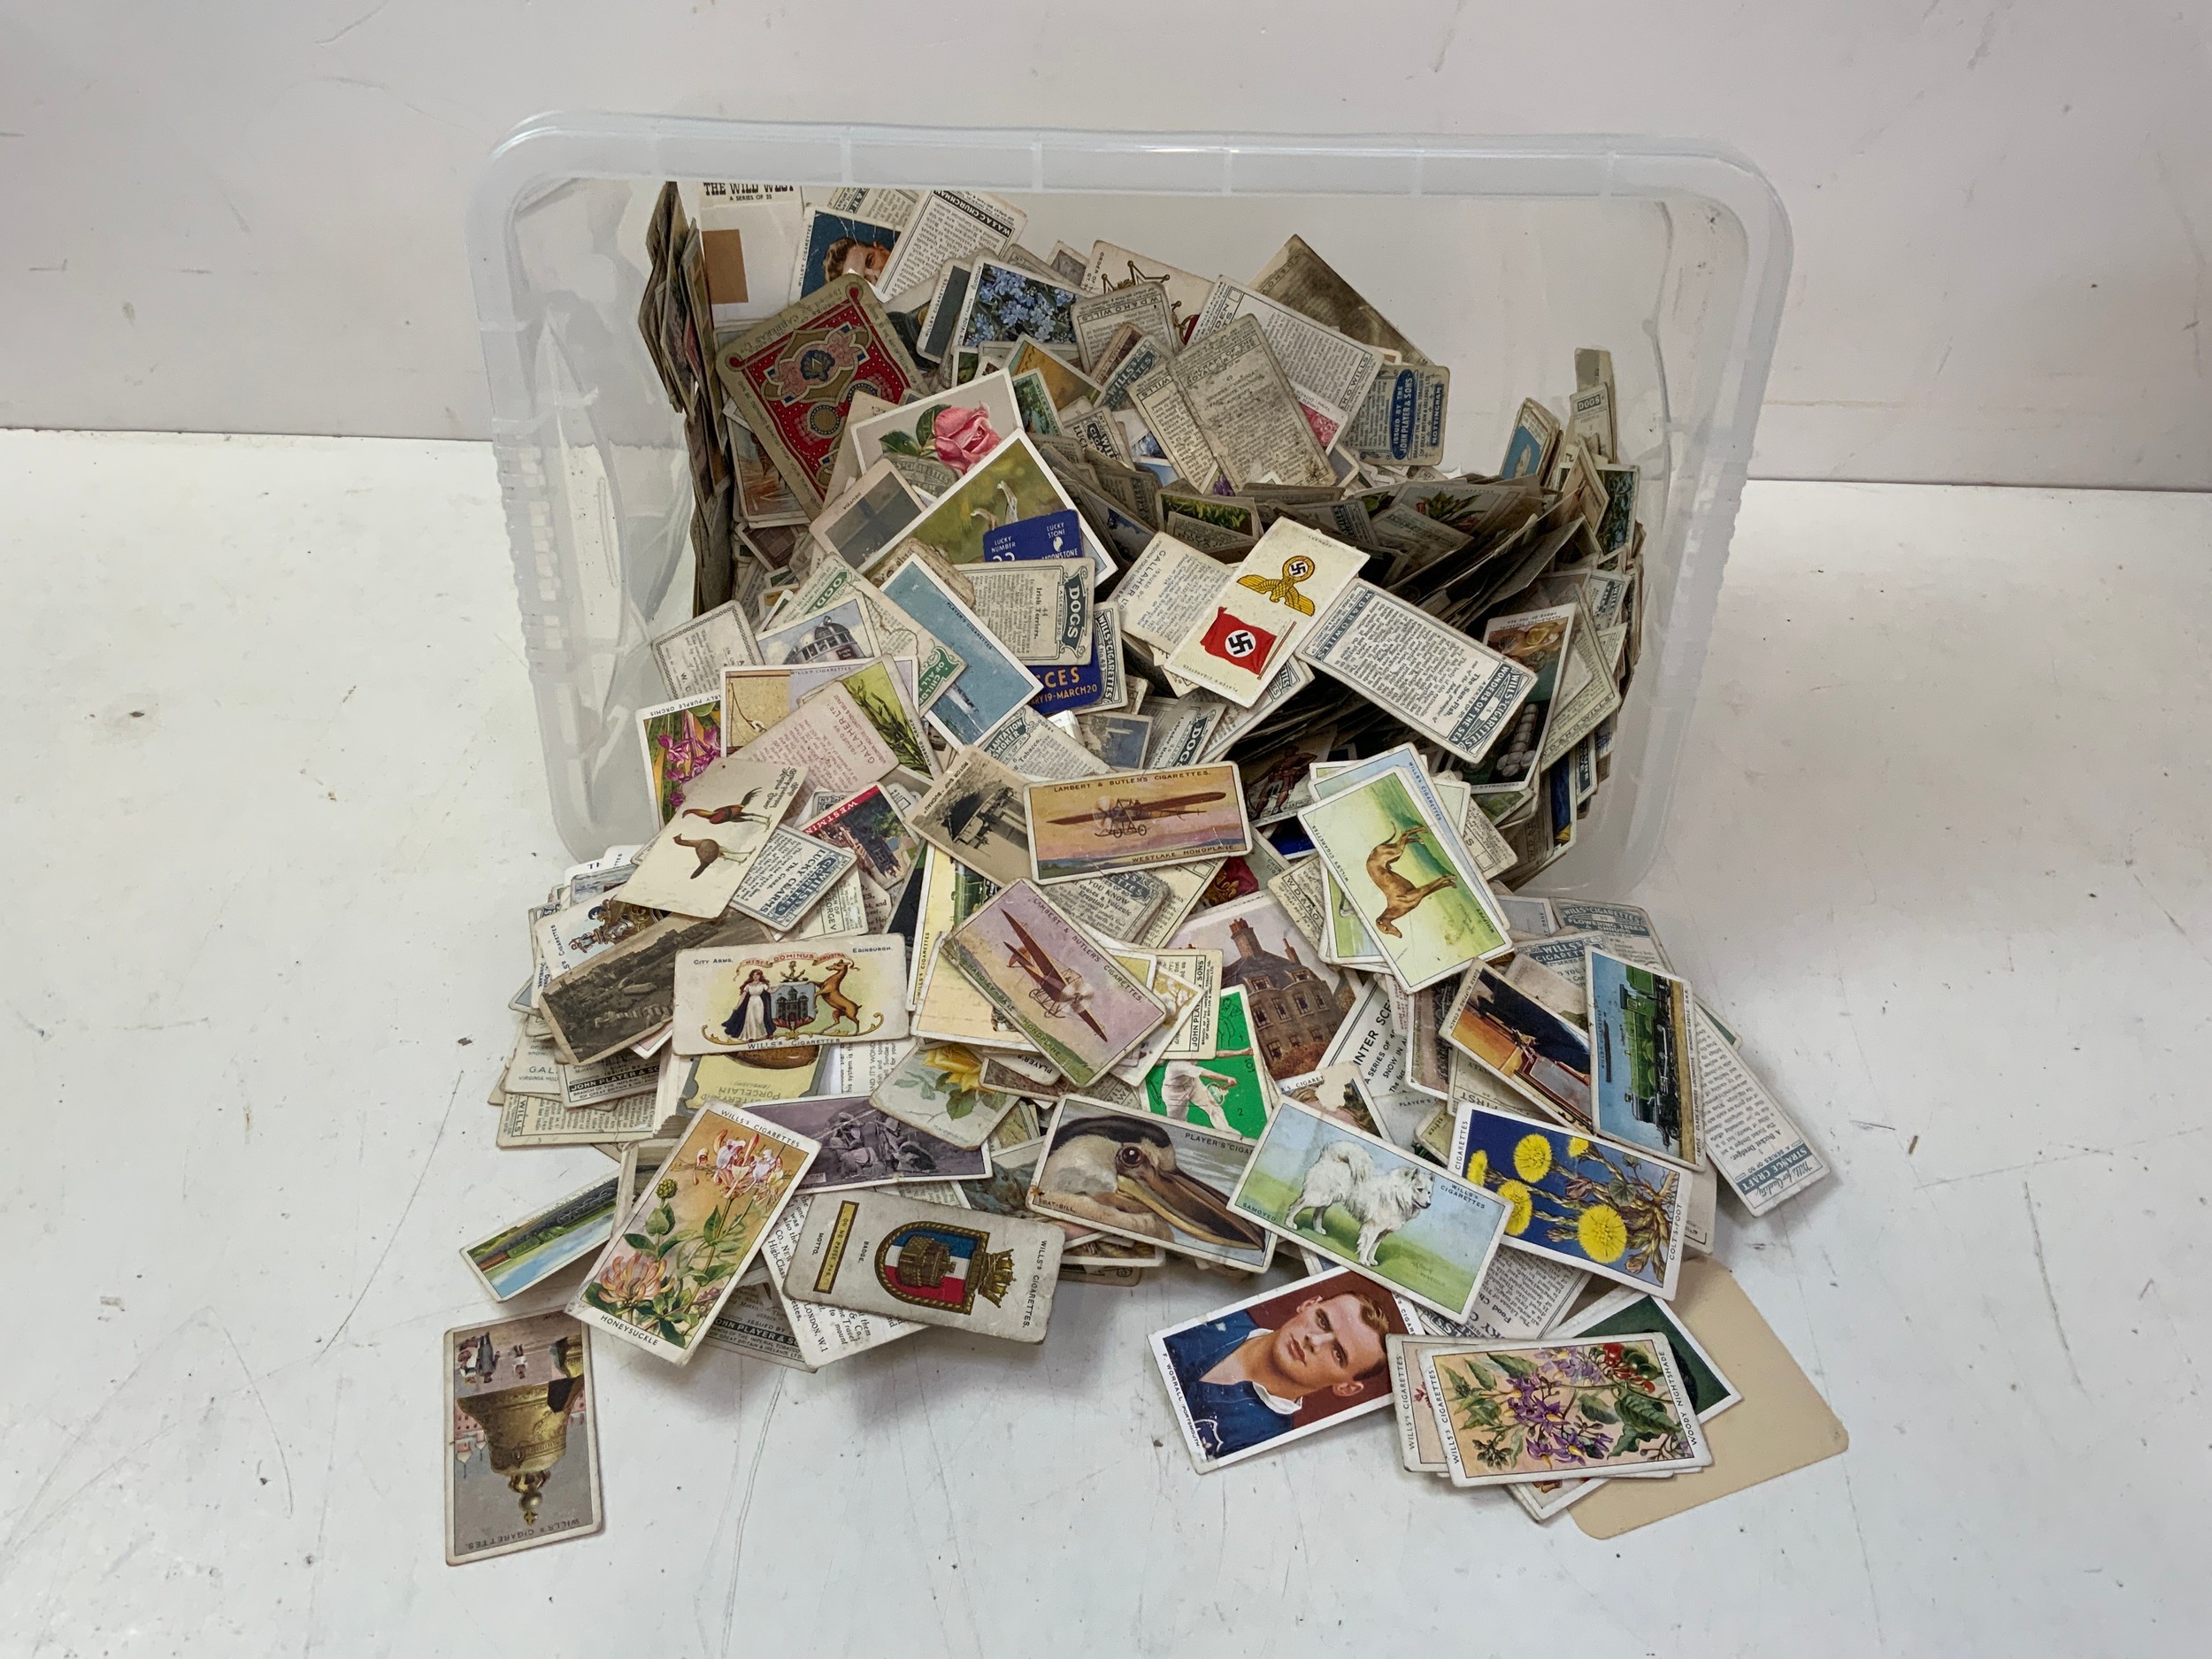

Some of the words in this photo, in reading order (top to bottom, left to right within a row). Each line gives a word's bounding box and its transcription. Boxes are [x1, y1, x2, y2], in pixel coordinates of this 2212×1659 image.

[703, 182, 726, 196] THE
[1140, 376, 1170, 398] WILLS
[1403, 377, 1412, 398] SONS
[1395, 403, 1401, 413] BY
[1577, 396, 1601, 410] DOGS
[1401, 407, 1409, 432] PLAYER
[1432, 386, 1441, 443] NOTTINGHAM
[1046, 522, 1065, 532] LUCKY
[1047, 528, 1065, 539] STONE
[990, 541, 1017, 554] NUMBER
[994, 535, 1012, 545] LUCKY
[1125, 544, 1167, 601] GALLAHER
[1064, 587, 1082, 638] DOGS
[945, 601, 967, 623] PLAYER'S
[965, 622, 993, 650] CIGARETTES
[933, 660, 945, 673] OF
[1098, 645, 1121, 700] CIGARETTES
[920, 669, 936, 688] ALL
[1467, 671, 1480, 687] The
[1479, 663, 1509, 704] WONDERS
[677, 695, 703, 711] PURPLE
[1468, 685, 1482, 704] SERIES
[648, 703, 675, 718] ORCHIS
[1472, 700, 1484, 713] OF
[907, 718, 921, 738] WRACK
[1461, 710, 1477, 728] THE
[1463, 696, 1507, 752] CIGARETTES
[836, 715, 876, 764] GALLAHER
[982, 718, 1026, 755] PLANTATION
[988, 729, 1024, 759] SMOKER
[1450, 725, 1465, 744] SEA
[916, 740, 934, 766] KNOBBED
[952, 761, 969, 778] ROTOR
[942, 777, 954, 789] SHIP
[1054, 781, 1091, 794] LAMBERT
[1418, 785, 1444, 821] CIGARETTES
[1310, 823, 1334, 859] CIGARETTES
[784, 859, 798, 873] The
[795, 845, 826, 878] LUCKY
[1132, 850, 1177, 864] WESTLAKE
[758, 874, 796, 916] CHARMS
[776, 854, 832, 917] CIGARETTES
[1078, 880, 1099, 901] causes
[1103, 885, 1131, 910] KNOW
[833, 904, 841, 915] OF
[1473, 906, 1497, 933] WHIPPET
[1032, 897, 1062, 926] LAMBERT
[1071, 933, 1102, 963] BUTLER'S
[773, 952, 814, 962] DOMINUS
[818, 952, 846, 962] FRUSTRA
[918, 931, 931, 969] CIGARETTES
[1190, 1025, 1199, 1047] JOHN
[1195, 959, 1204, 980] SONS
[1448, 1012, 1460, 1030] COACH
[1016, 1052, 1053, 1074] PLAYER'S
[1365, 1050, 1388, 1078] SERIES
[1381, 1039, 1393, 1051] OF
[1379, 1055, 1401, 1079] SNOW
[1394, 1046, 1405, 1057] IN
[570, 1079, 596, 1092] JOHN
[598, 1069, 638, 1087] PLAYER
[845, 1060, 854, 1081] system
[1387, 1079, 1399, 1093] The
[1398, 1097, 1432, 1108] PLAYER'S
[510, 1099, 530, 1133] WILLS
[1425, 1116, 1443, 1136] SETTER
[753, 1121, 800, 1149] CIGARETTES
[1184, 1130, 1226, 1150] PLAYER'S
[1451, 1120, 1471, 1170] CIGARETTES
[1754, 1132, 1776, 1148] Bucket
[1728, 1142, 1756, 1163] Dredger.
[1763, 1148, 1785, 1164] SERIES
[1769, 1145, 1809, 1173] STRANGE
[1753, 1160, 1763, 1169] OF
[1739, 1168, 1771, 1190] CRAFT
[1754, 1176, 1786, 1200] Quality
[1779, 1170, 1794, 1185] for
[1440, 1184, 1486, 1210] CIGARETTES
[1241, 1199, 1277, 1225] SAMOYED
[782, 1216, 793, 1232] also
[788, 1231, 798, 1245] the
[836, 1228, 845, 1240] NE
[1666, 1202, 1686, 1261] COLT'S-FOOT
[808, 1231, 825, 1256] MOTTO.
[829, 1240, 841, 1261] PASSE
[765, 1238, 788, 1279] High-Class
[746, 1317, 773, 1330] ISSUED
[803, 1302, 822, 1337] LONDON,
[1492, 1304, 1511, 1324] Food
[599, 1310, 659, 1349] HONEYSUCKLE
[736, 1323, 775, 1340] PLAYER
[776, 1333, 785, 1342] &
[828, 1308, 836, 1317] to
[833, 1322, 848, 1346] mount
[841, 1317, 857, 1343] Travel
[860, 1317, 872, 1337] them
[1161, 1352, 1168, 1361] F.
[1164, 1363, 1186, 1402] WORRALL
[1395, 1355, 1409, 1409] CIGARETTES
[1657, 1349, 1684, 1408] NIGHTSHADE
[1427, 1369, 1448, 1424] CIGARETTES
[1678, 1409, 1698, 1446] WOODY
